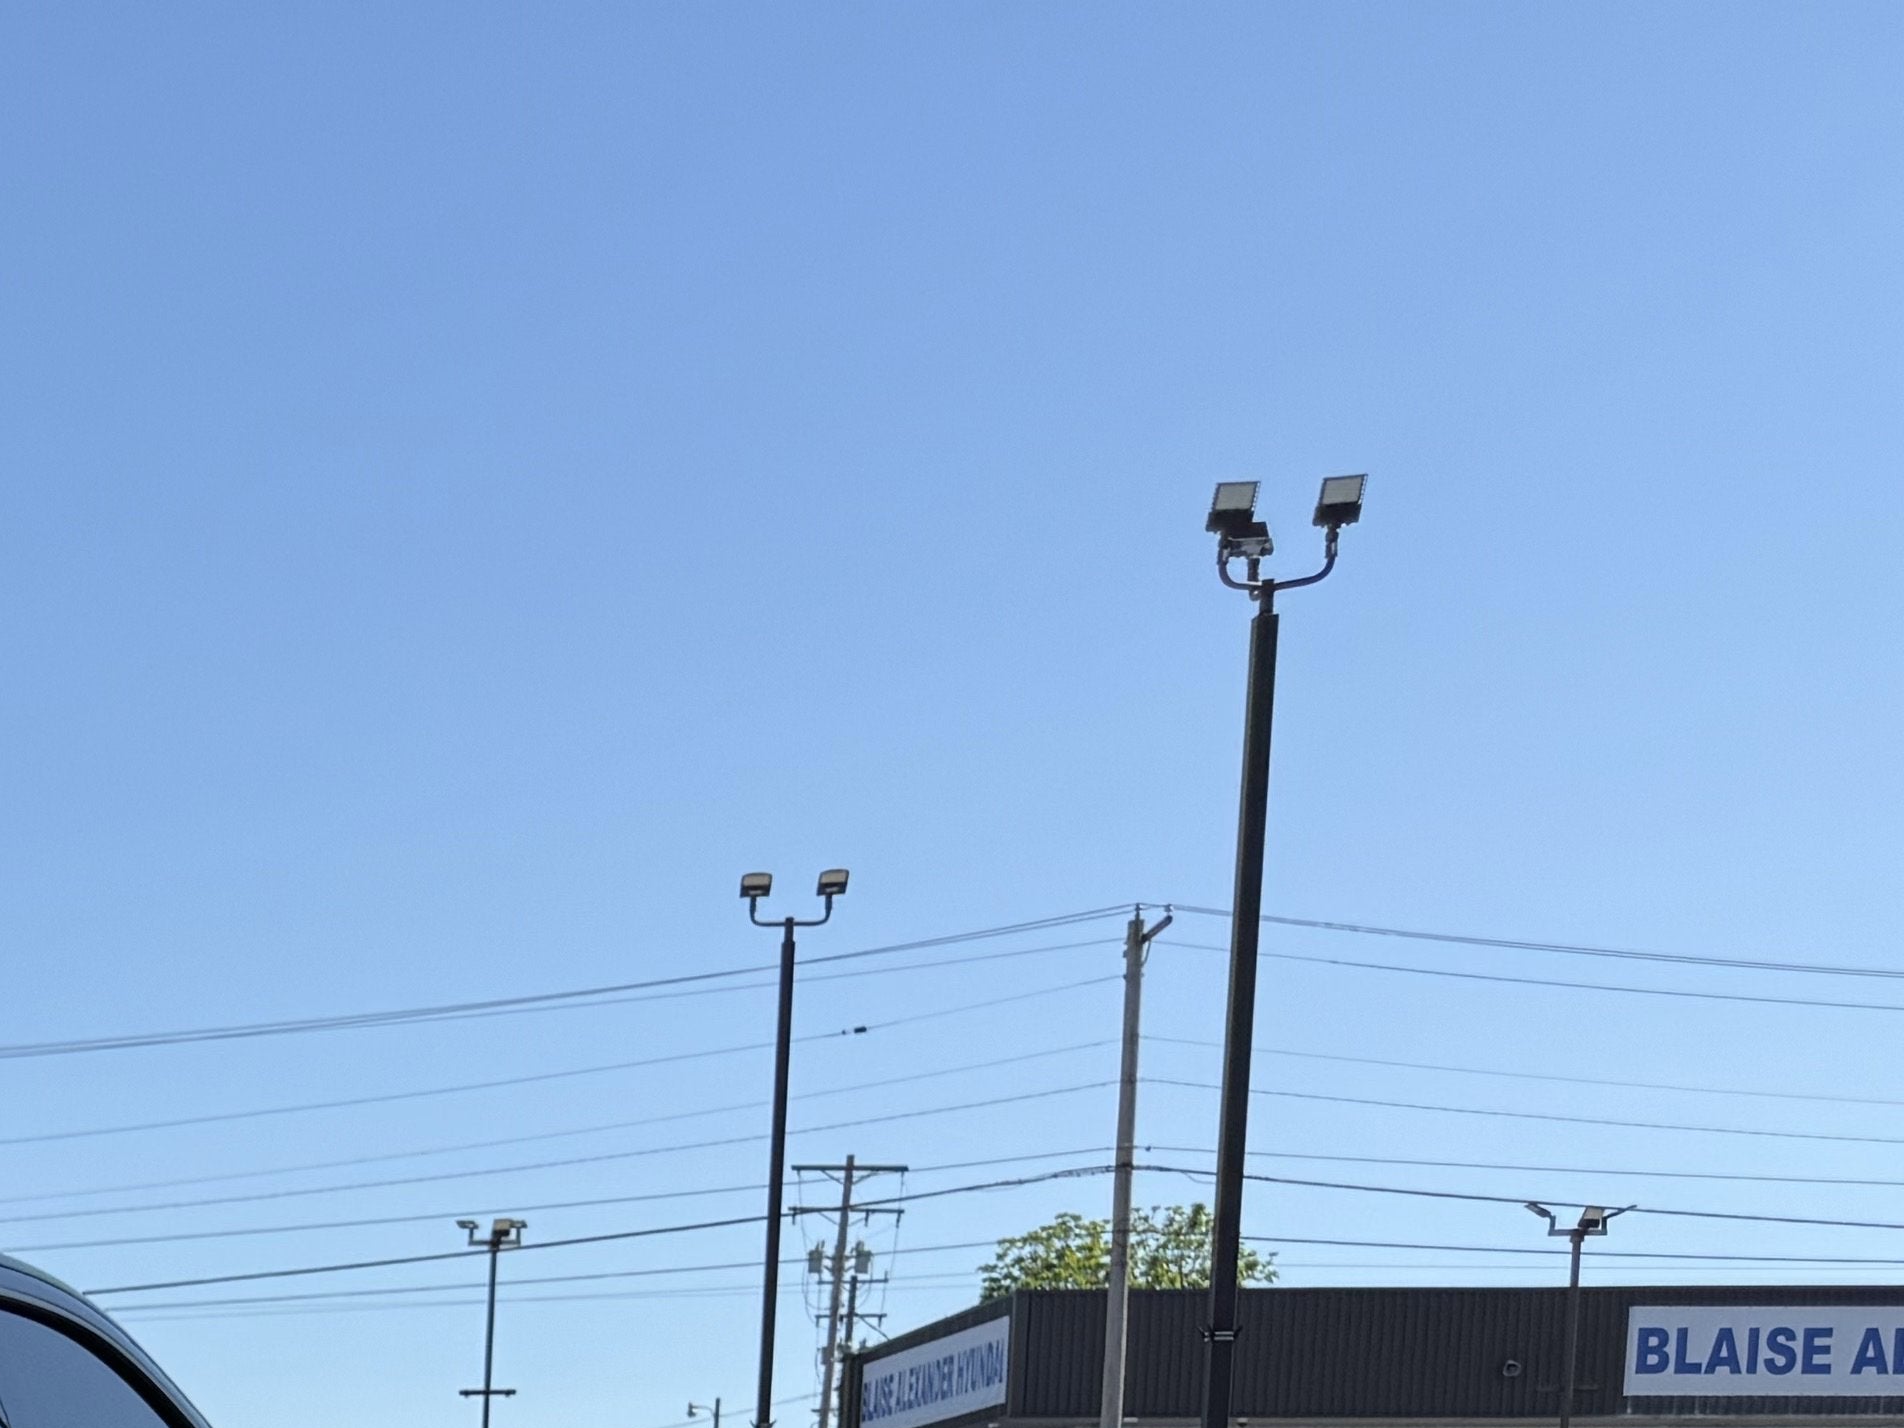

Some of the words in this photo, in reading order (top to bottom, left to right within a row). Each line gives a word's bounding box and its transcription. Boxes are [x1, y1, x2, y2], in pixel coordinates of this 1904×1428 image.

[862, 1372, 895, 1423] BLAISE
[895, 1354, 955, 1414] ALEXANDER
[956, 1338, 1005, 1396] HYUNDAI
[1634, 1326, 1834, 1376] BLAISE
